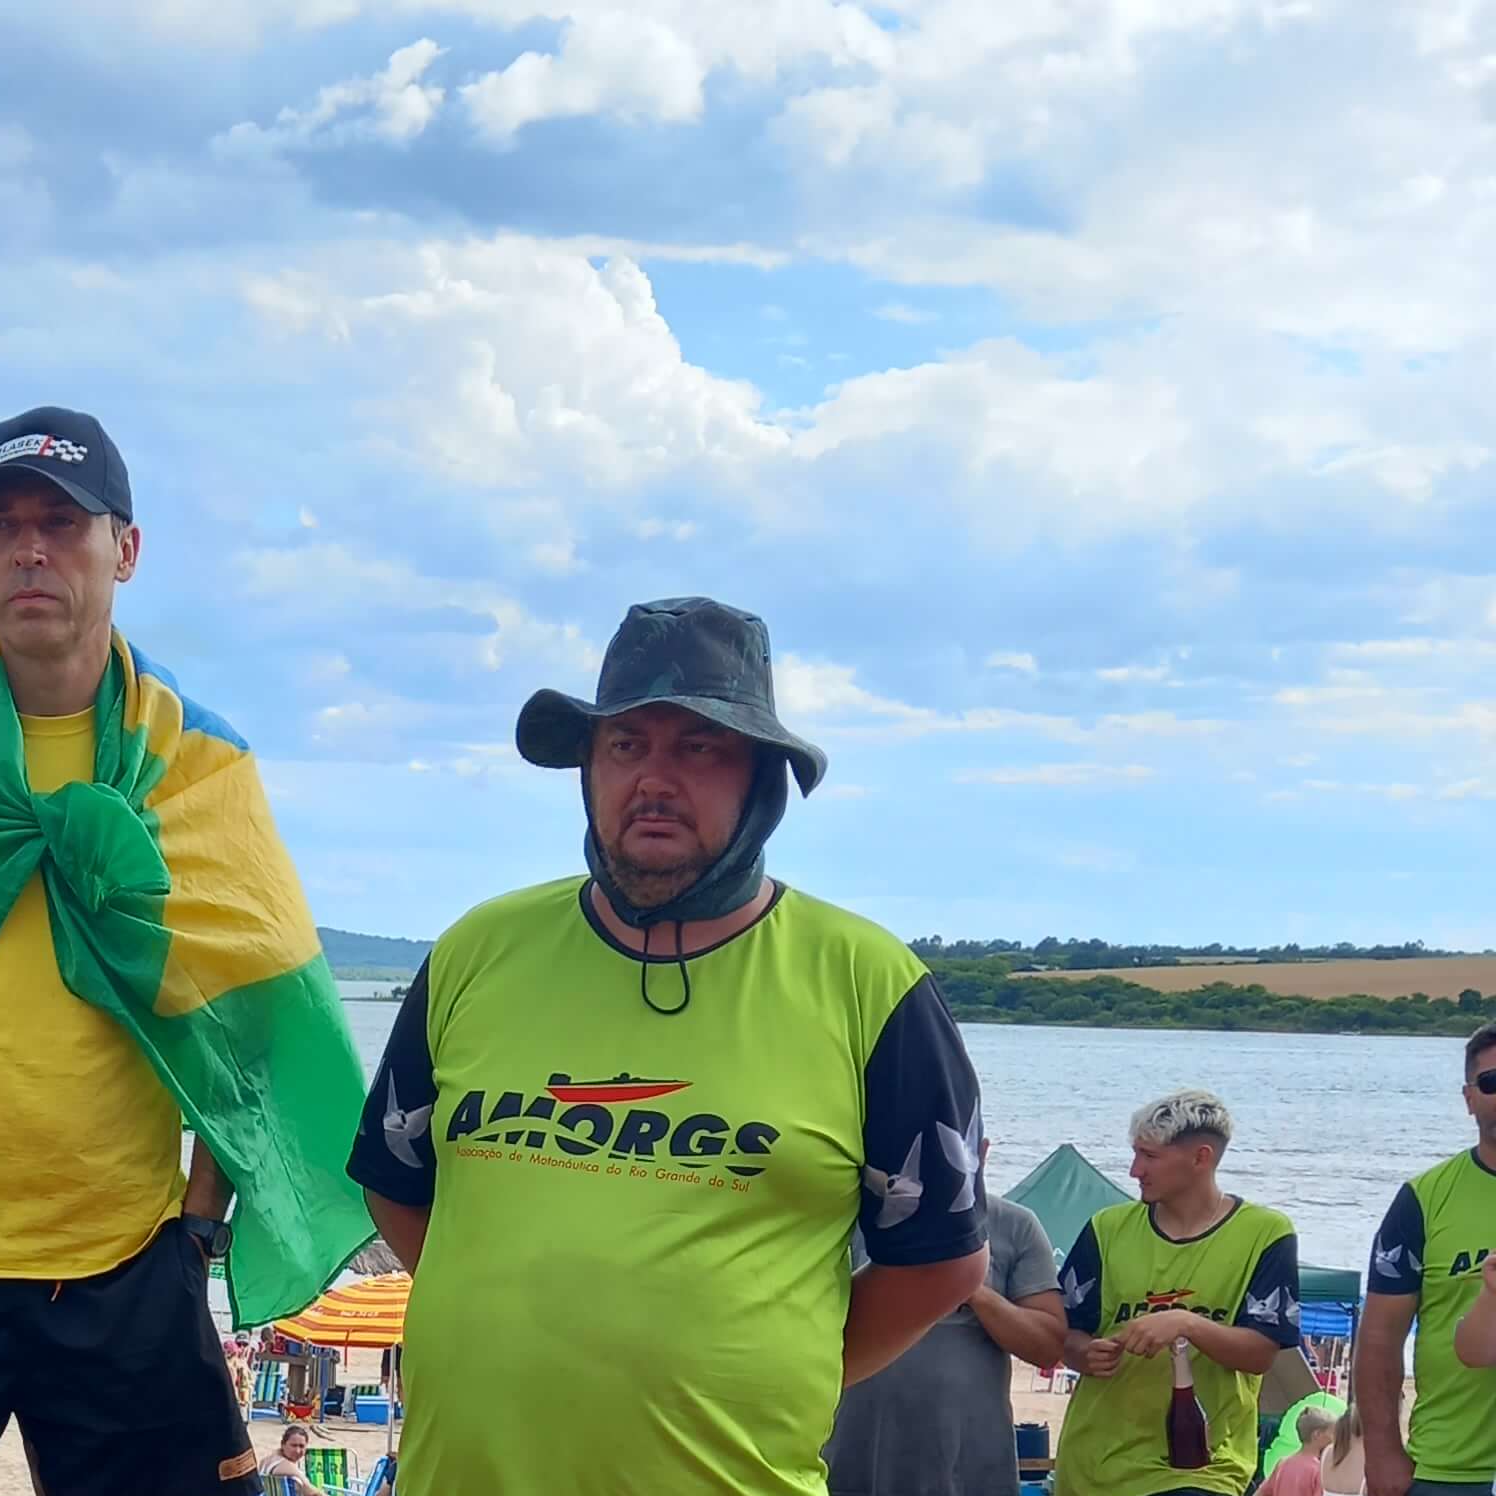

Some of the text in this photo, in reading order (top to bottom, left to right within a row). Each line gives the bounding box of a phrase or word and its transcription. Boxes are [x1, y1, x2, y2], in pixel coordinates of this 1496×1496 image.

[447, 1090, 781, 1177] AMORGS
[509, 1148, 523, 1162] de
[530, 1153, 600, 1173] Motonáutica
[606, 1164, 622, 1176] do
[629, 1164, 648, 1179] Rio
[655, 1168, 701, 1185] Grande
[708, 1175, 725, 1188] do
[731, 1178, 751, 1193] Sul
